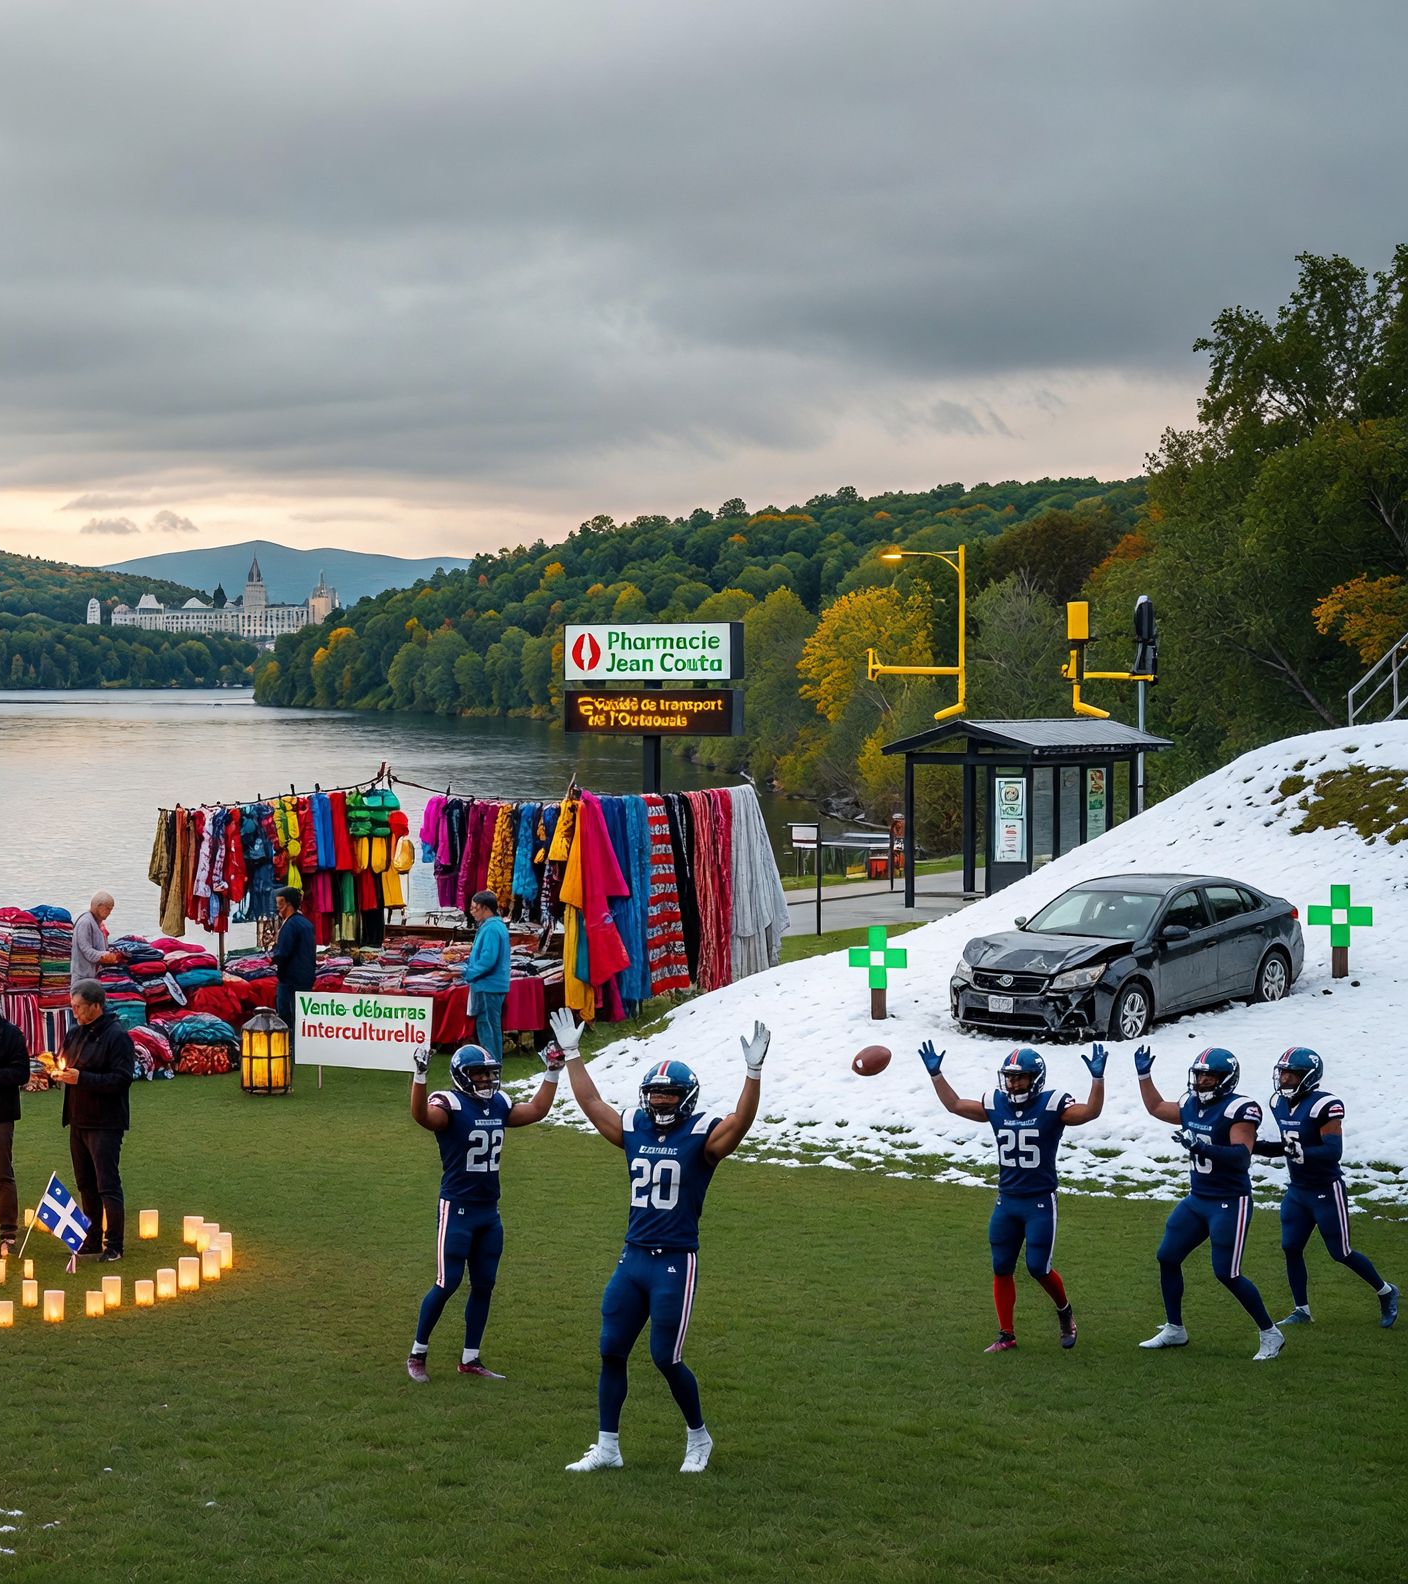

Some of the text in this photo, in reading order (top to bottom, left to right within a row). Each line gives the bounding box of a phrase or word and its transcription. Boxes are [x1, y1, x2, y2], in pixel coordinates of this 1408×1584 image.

[608, 630, 720, 650] Pharmacie
[606, 653, 654, 672] Jean
[466, 1129, 505, 1173] 22
[997, 1128, 1041, 1169] 25
[630, 1157, 681, 1210] 20
